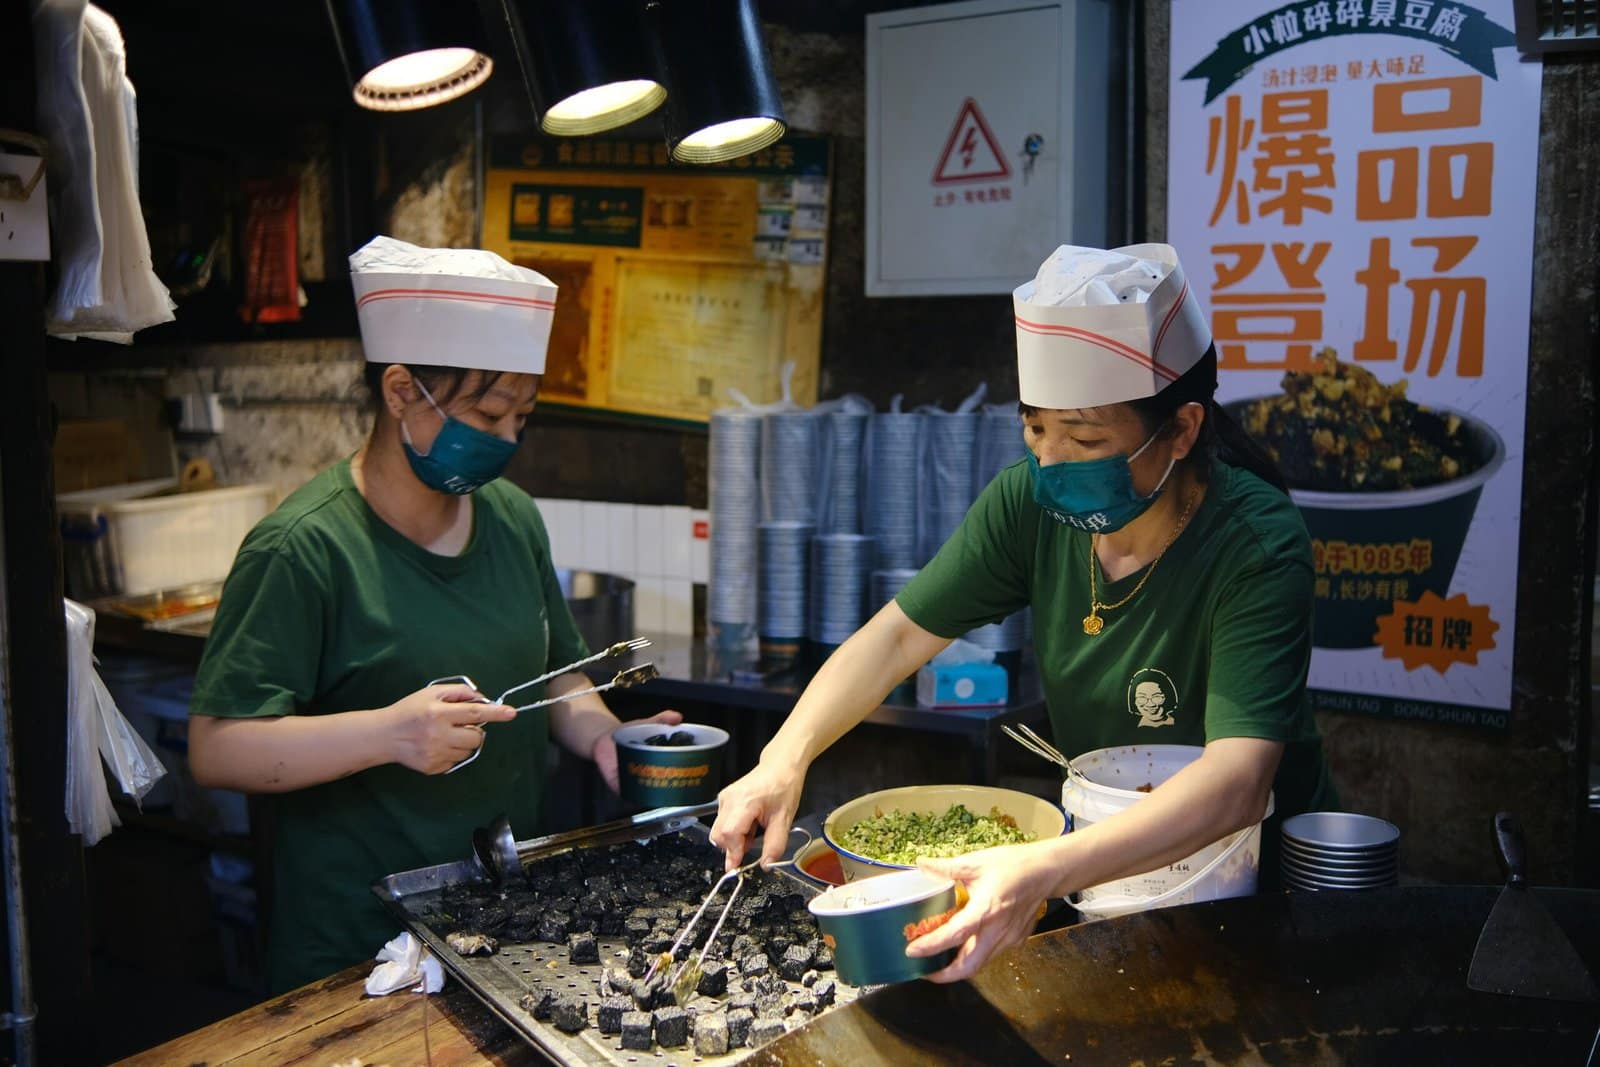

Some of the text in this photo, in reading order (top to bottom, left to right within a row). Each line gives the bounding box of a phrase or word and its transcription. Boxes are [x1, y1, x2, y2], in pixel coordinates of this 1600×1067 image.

[1347, 54, 1426, 80] 量大味足
[1206, 75, 1494, 227] 爆品
[1209, 235, 1487, 378] 登场
[1403, 614, 1473, 650] 招牌
[1394, 702, 1434, 720] DONG
[1437, 708, 1476, 724] SHUN
[1480, 713, 1506, 728] TAO
